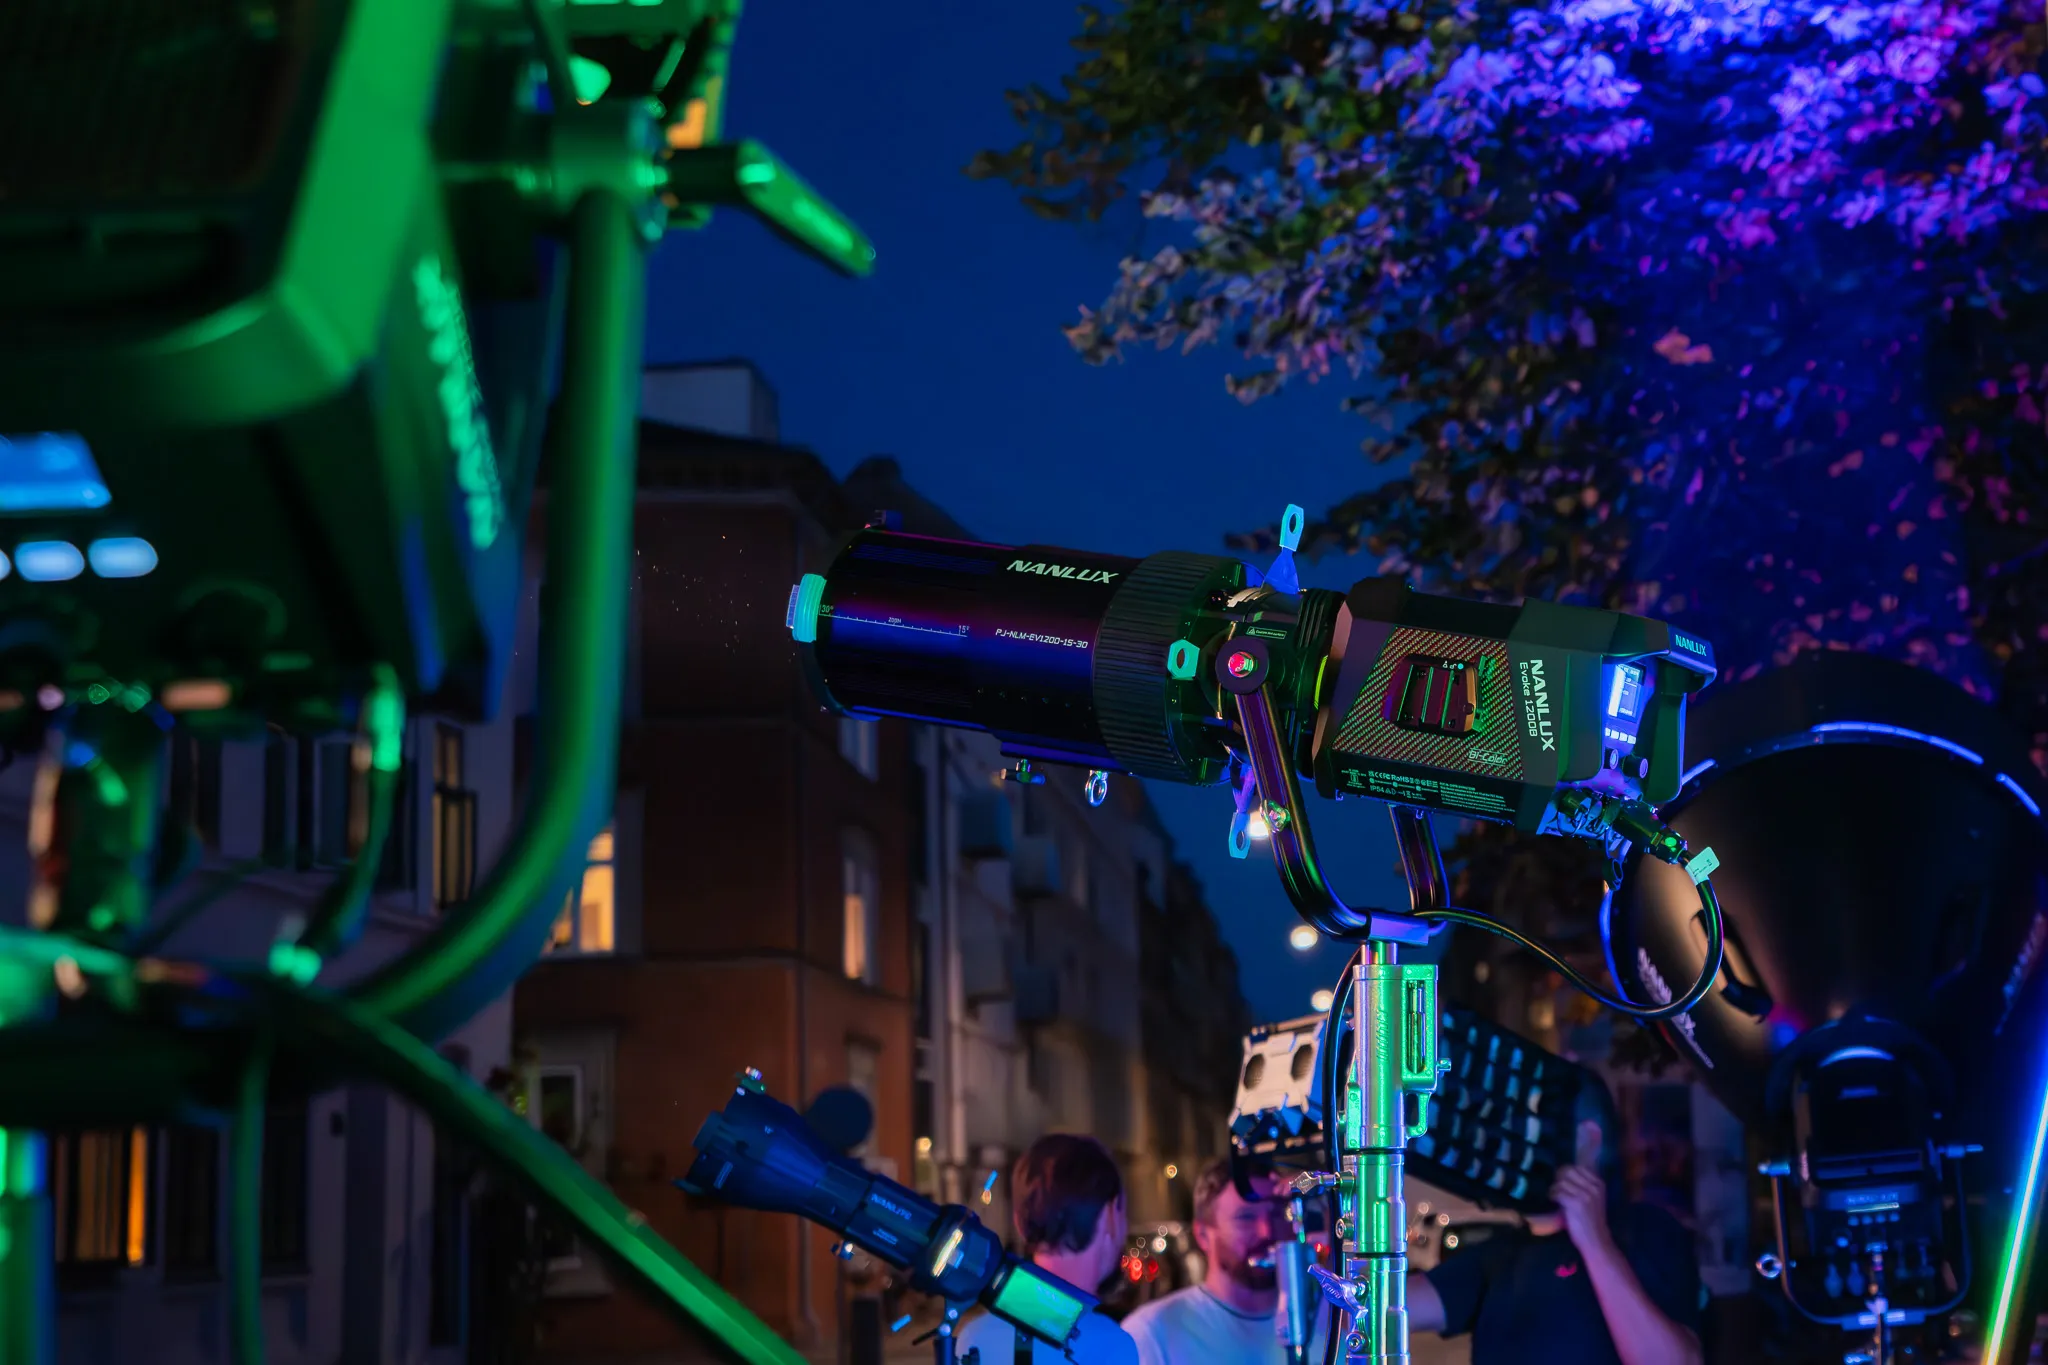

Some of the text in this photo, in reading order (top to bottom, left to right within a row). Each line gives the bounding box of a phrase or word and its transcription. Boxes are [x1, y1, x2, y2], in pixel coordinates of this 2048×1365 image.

[1006, 560, 1119, 584] NANLUX
[995, 628, 1089, 649] PJ-NLM-EV1200-15-30
[1675, 634, 1707, 657] NANLUX
[1519, 661, 1538, 737] Evoke 1200B
[1530, 659, 1556, 752] NANLUX
